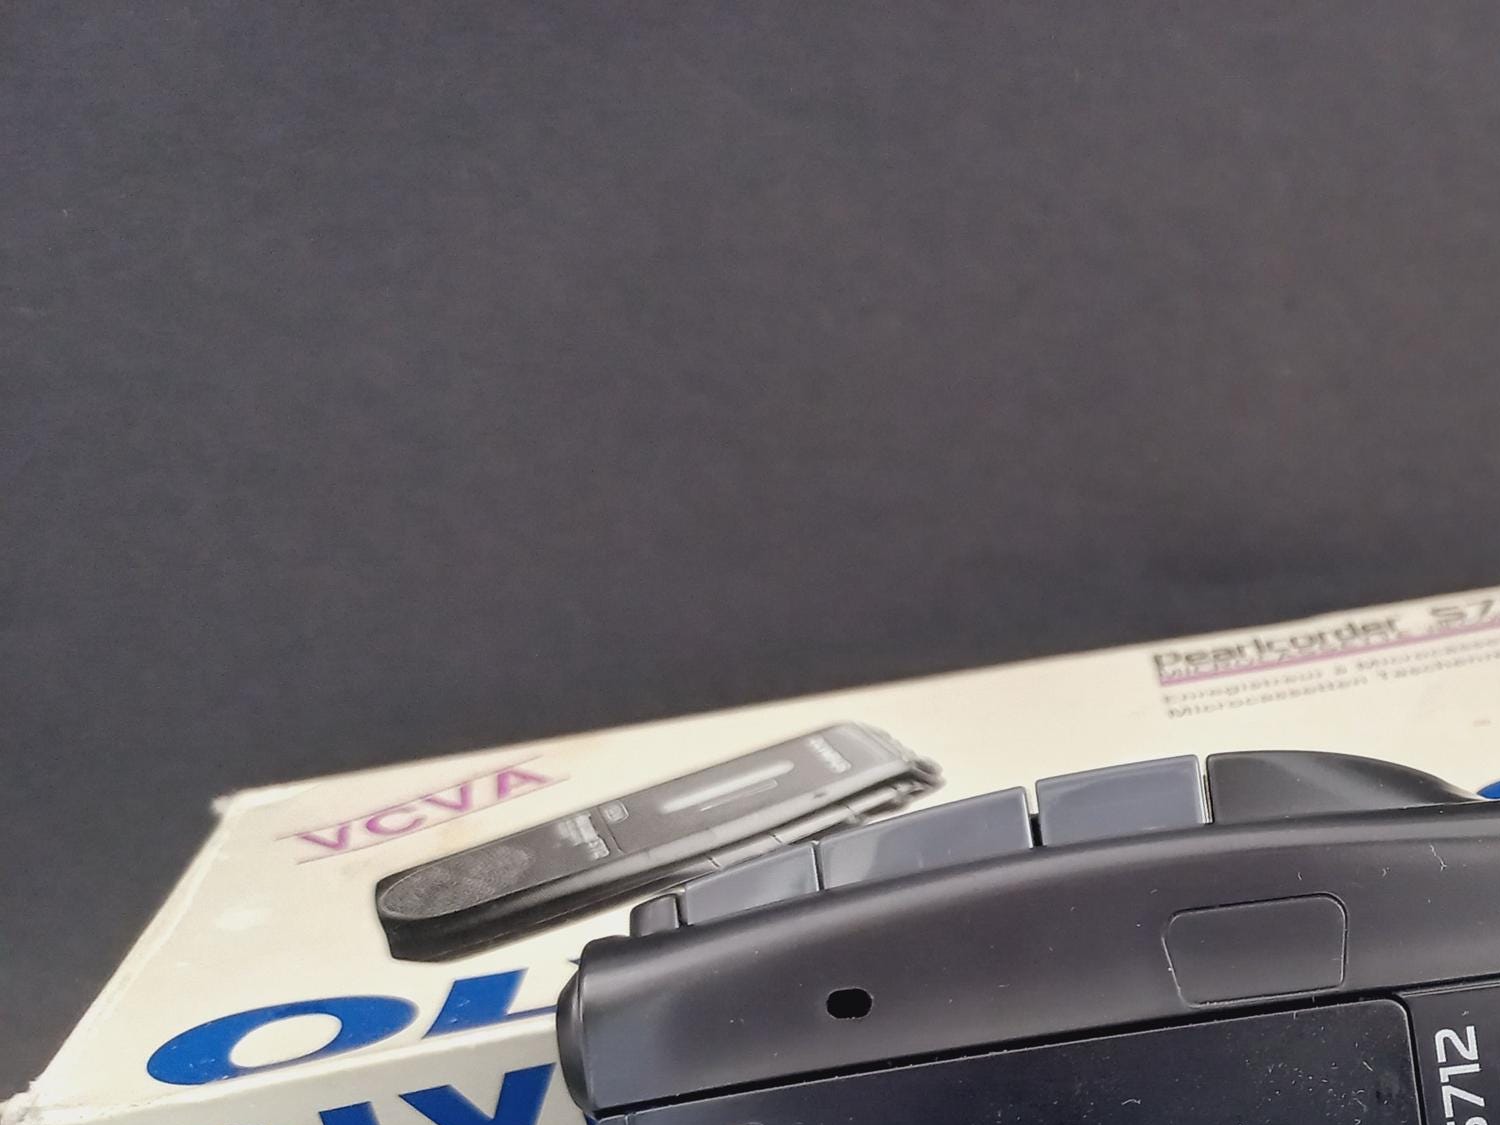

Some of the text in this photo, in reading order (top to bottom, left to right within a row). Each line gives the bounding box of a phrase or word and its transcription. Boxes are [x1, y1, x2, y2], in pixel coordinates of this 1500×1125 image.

[1154, 618, 1396, 674] Pearlcorder
[297, 770, 551, 850] VCVA
[147, 966, 560, 1086] OL
